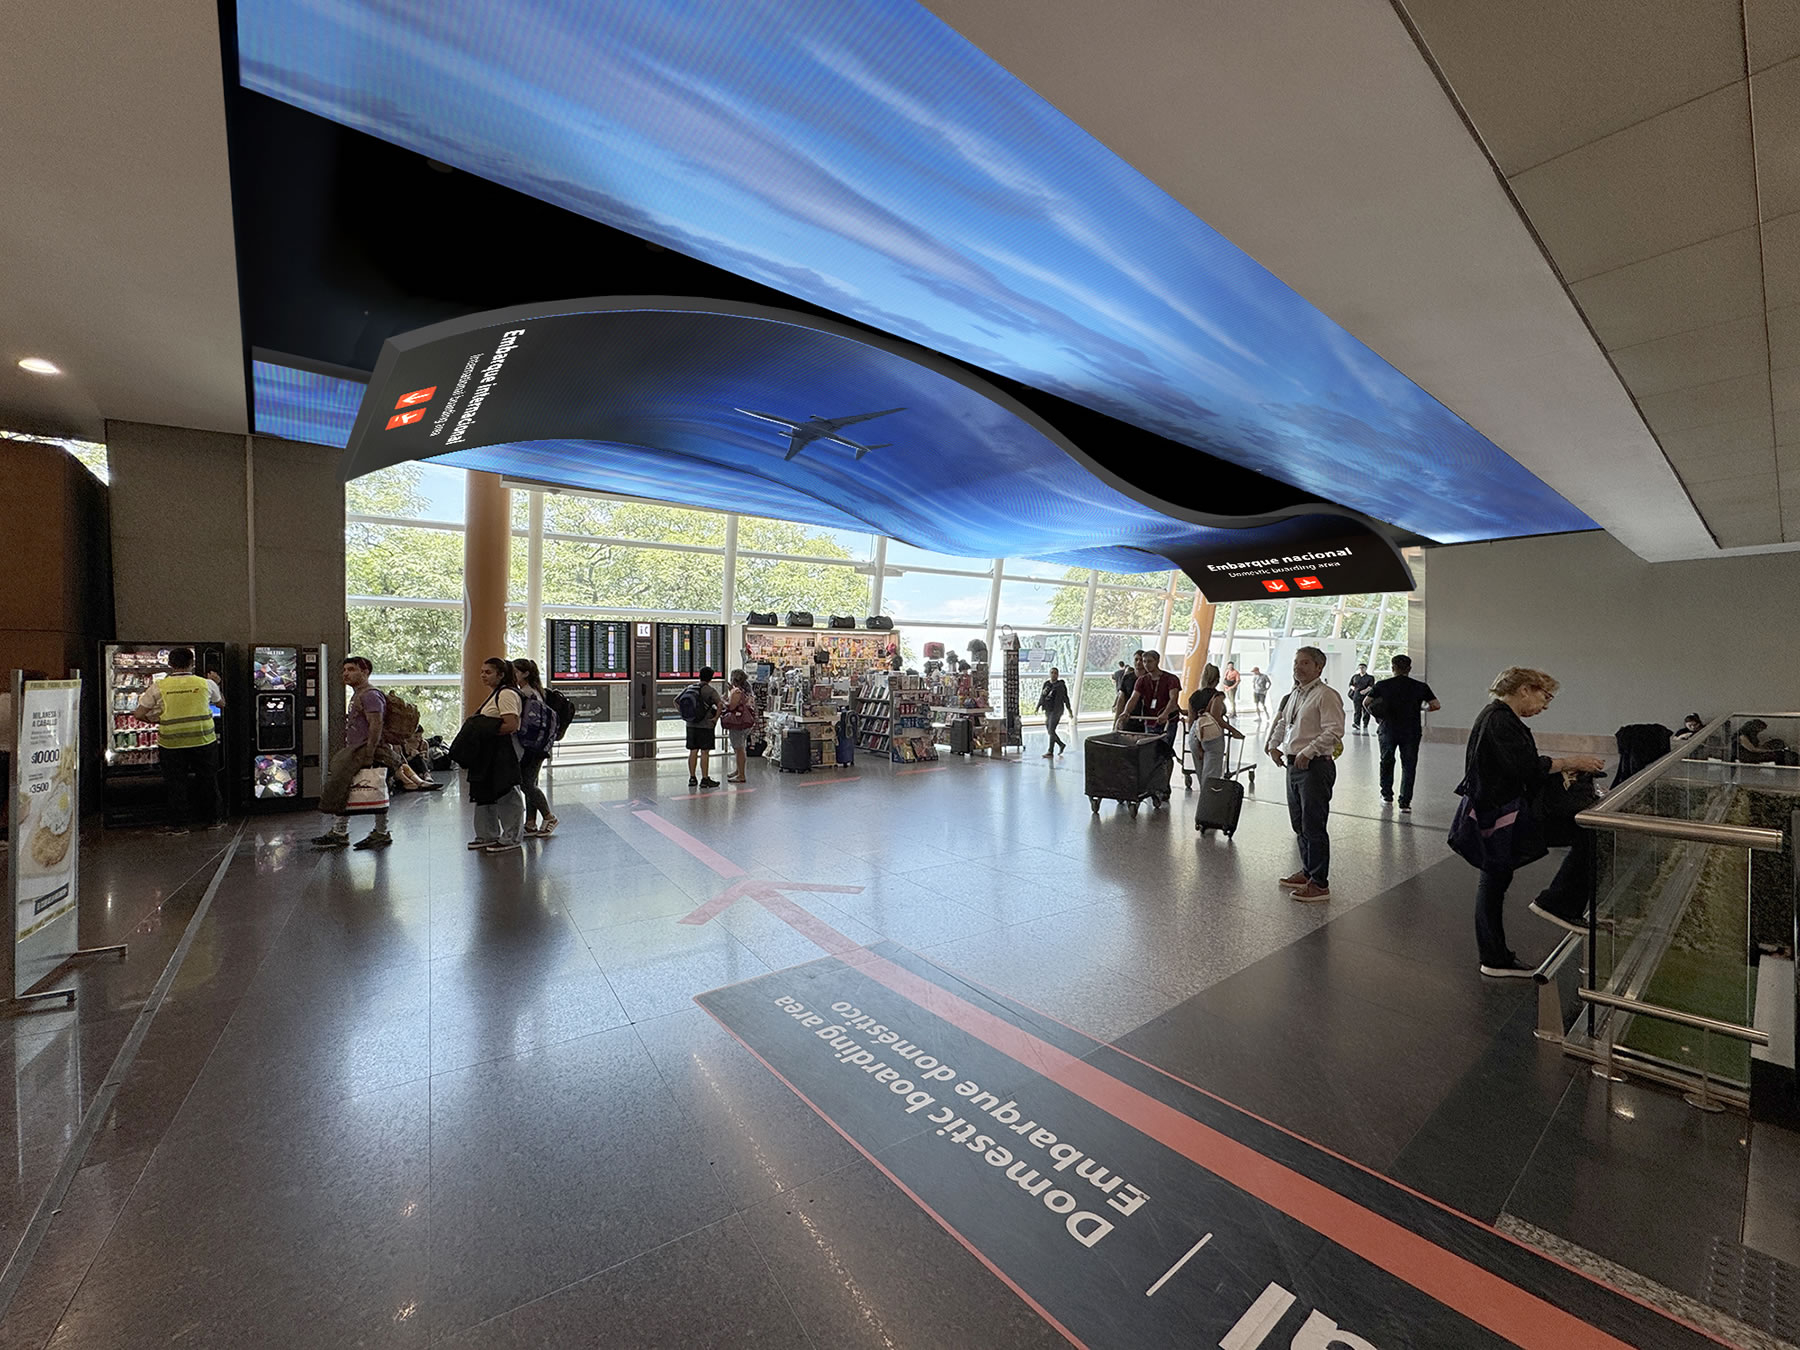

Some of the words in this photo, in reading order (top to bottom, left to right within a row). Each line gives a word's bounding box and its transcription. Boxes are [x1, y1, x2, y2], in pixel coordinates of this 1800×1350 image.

[480, 329, 526, 384] Embarque
[445, 382, 498, 445] internacional
[1206, 557, 1280, 572] Embarque
[1281, 547, 1353, 564] nacional
[1228, 568, 1271, 578] Domestic
[1271, 564, 1316, 574] boarding
[774, 995, 824, 1028] area
[831, 1001, 957, 1081] doméstico
[815, 1025, 936, 1114] boarding
[927, 1106, 1116, 1249] Domestic
[954, 1080, 1151, 1217] Embarque
